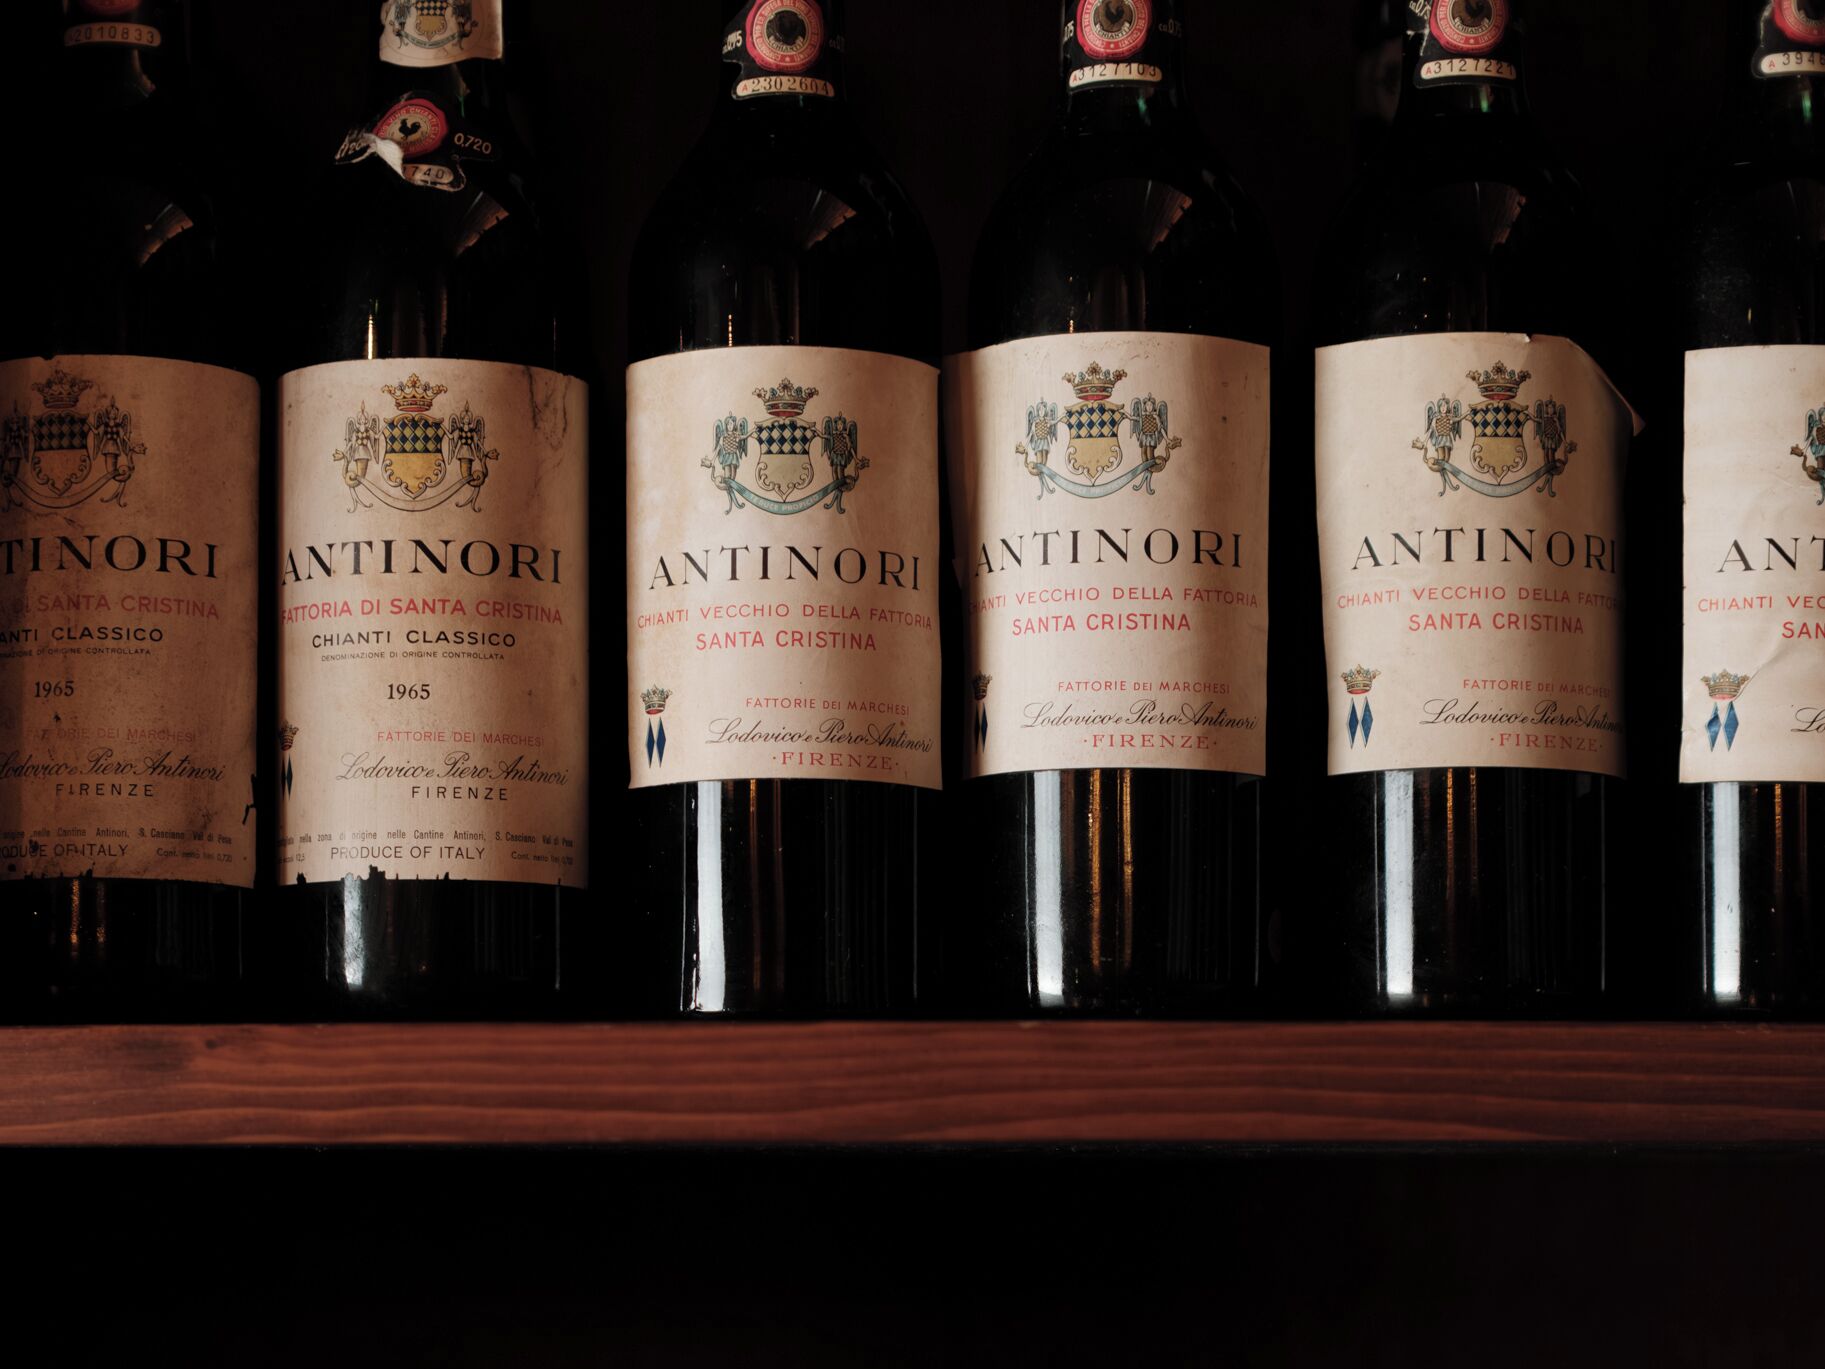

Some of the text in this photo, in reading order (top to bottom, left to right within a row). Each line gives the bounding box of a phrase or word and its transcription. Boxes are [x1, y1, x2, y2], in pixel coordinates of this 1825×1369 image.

[1434, 60, 1513, 76] 3127221
[454, 132, 492, 155] 0,720
[975, 527, 1243, 577] ANTINORI
[1351, 527, 1617, 575] ANTINORI
[281, 538, 563, 586] ANTINORI
[648, 544, 921, 591] ANTINORI
[37, 594, 220, 619] SANTA CRISTINA
[1015, 587, 1259, 609] VECCHIO DELLA FATTORIA
[1337, 586, 1571, 609] CHIANTI VECCHIO DELLA
[1697, 596, 1774, 613] CHIANTI
[281, 597, 563, 626] FATTORIA DI SANTA CRISTINA
[637, 603, 933, 631] CHIANTI VECCHIO DELLA FATTORIA
[1011, 613, 1191, 636] SANTA CRISTINA
[1408, 613, 1585, 634] SANTA CRISTINA
[51, 626, 165, 644] CLASSICO
[311, 629, 517, 648] CHIANTI CLASSICO
[695, 630, 877, 651] SANTA CRISTINA
[320, 651, 505, 662] DENOMINAZIONE ORIGINE CONTROLLATA
[34, 680, 76, 699] 1965
[386, 683, 431, 700] 1965
[1058, 680, 1231, 695] FATTORIE DEI MARCHESI
[1463, 679, 1613, 699] FATTORIE DEI MARCHESI
[745, 697, 911, 716] FATTORIE DEI MARCHESI
[1020, 698, 1260, 732] Lodovico Piero Antinori
[1418, 698, 1581, 726] Lodovico Piero
[25, 728, 197, 745] FATTORIE DEI MARCHESI
[376, 730, 544, 748] FATTORIE DEI MARCHESI
[704, 717, 935, 753] Lodovico Piero Antinori
[133, 750, 227, 783] Antinori
[435, 751, 487, 780] Piero
[489, 753, 570, 787] Antinori
[56, 783, 155, 798] FIRENZE
[411, 786, 509, 801] FIRENZE
[386, 829, 407, 840] nelle
[413, 829, 445, 840] Cantine
[81, 843, 129, 858] ITALY
[330, 846, 486, 860] PRODUCE OF ITALY
